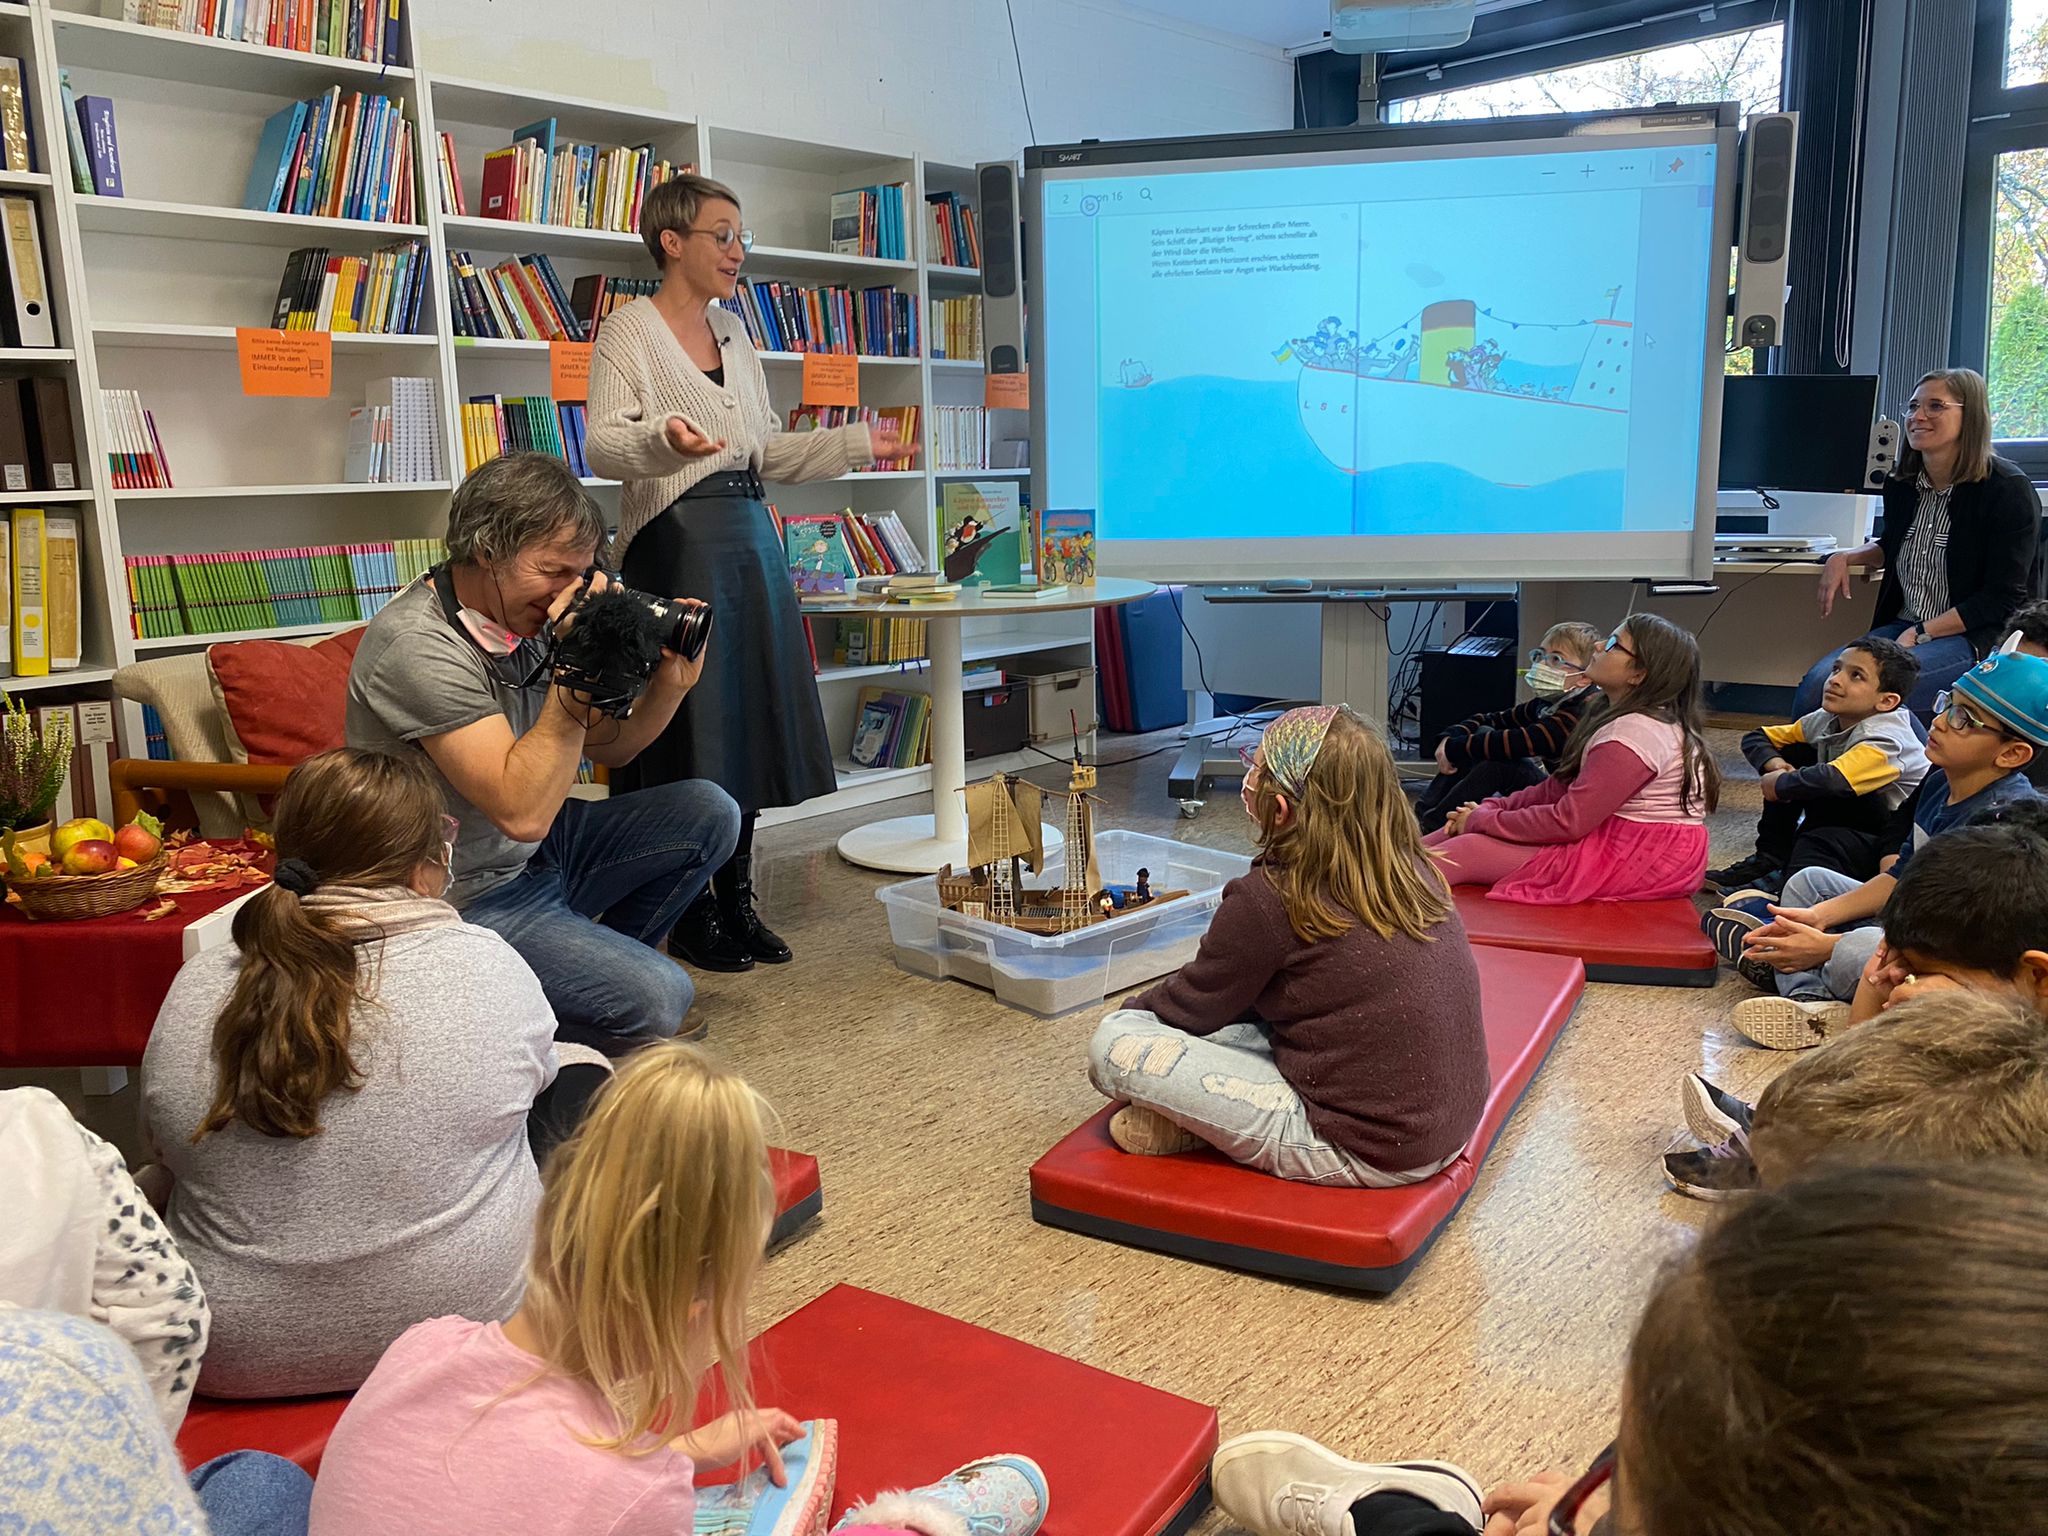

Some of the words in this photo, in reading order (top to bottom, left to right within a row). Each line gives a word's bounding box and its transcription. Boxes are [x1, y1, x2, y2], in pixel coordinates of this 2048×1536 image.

[1058, 153, 1082, 161] SMART
[1062, 194, 1069, 204] 2
[1112, 191, 1123, 201] 16
[252, 363, 308, 373] Einkaufswagen!
